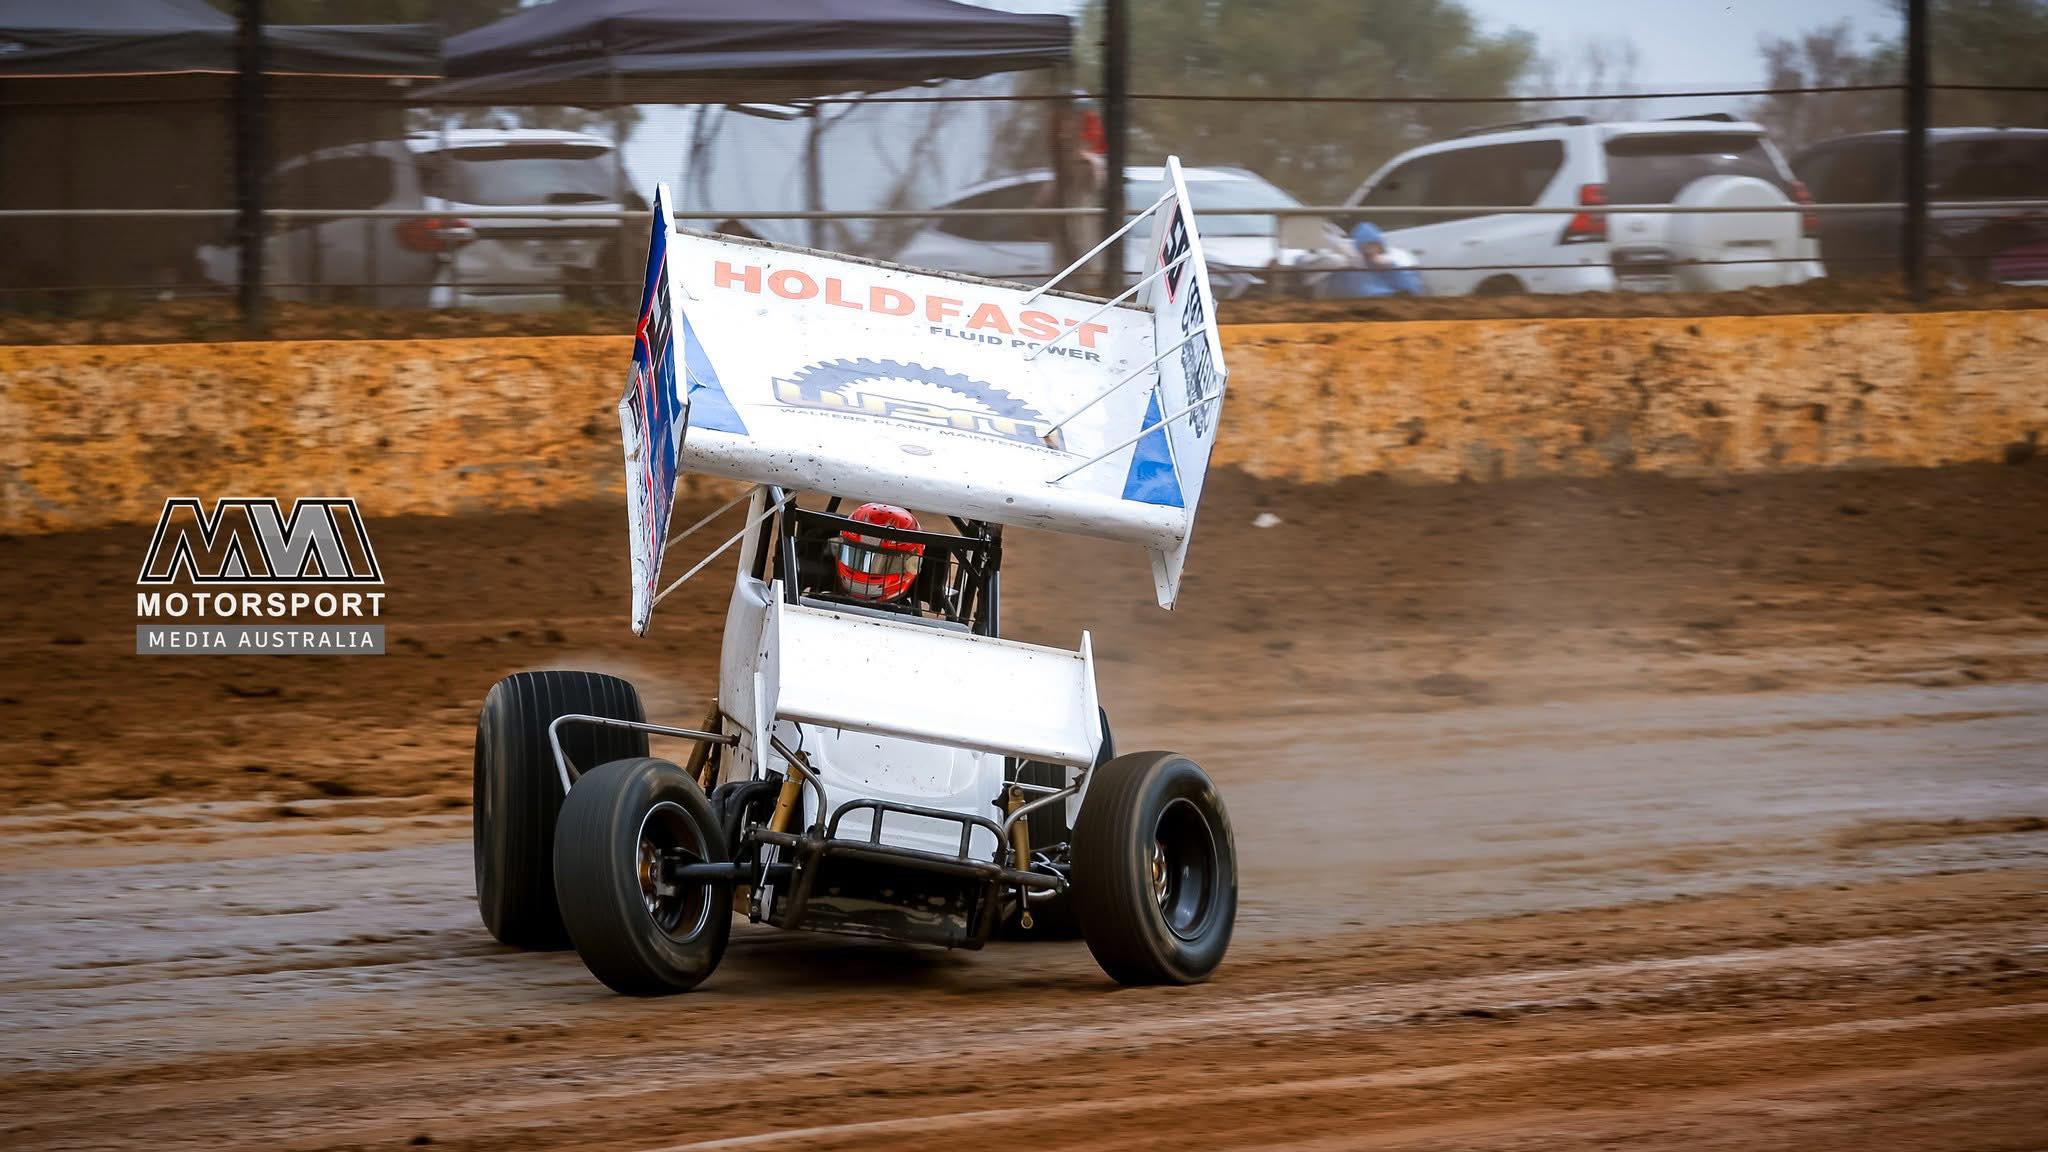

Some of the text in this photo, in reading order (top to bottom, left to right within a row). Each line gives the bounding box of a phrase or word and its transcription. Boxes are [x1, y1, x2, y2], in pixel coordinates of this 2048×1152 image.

[714, 260, 1109, 348] HOLDFAST
[930, 326, 1003, 345] FLUID
[780, 408, 1073, 459] WALKERS PLANT MAINTENANCE
